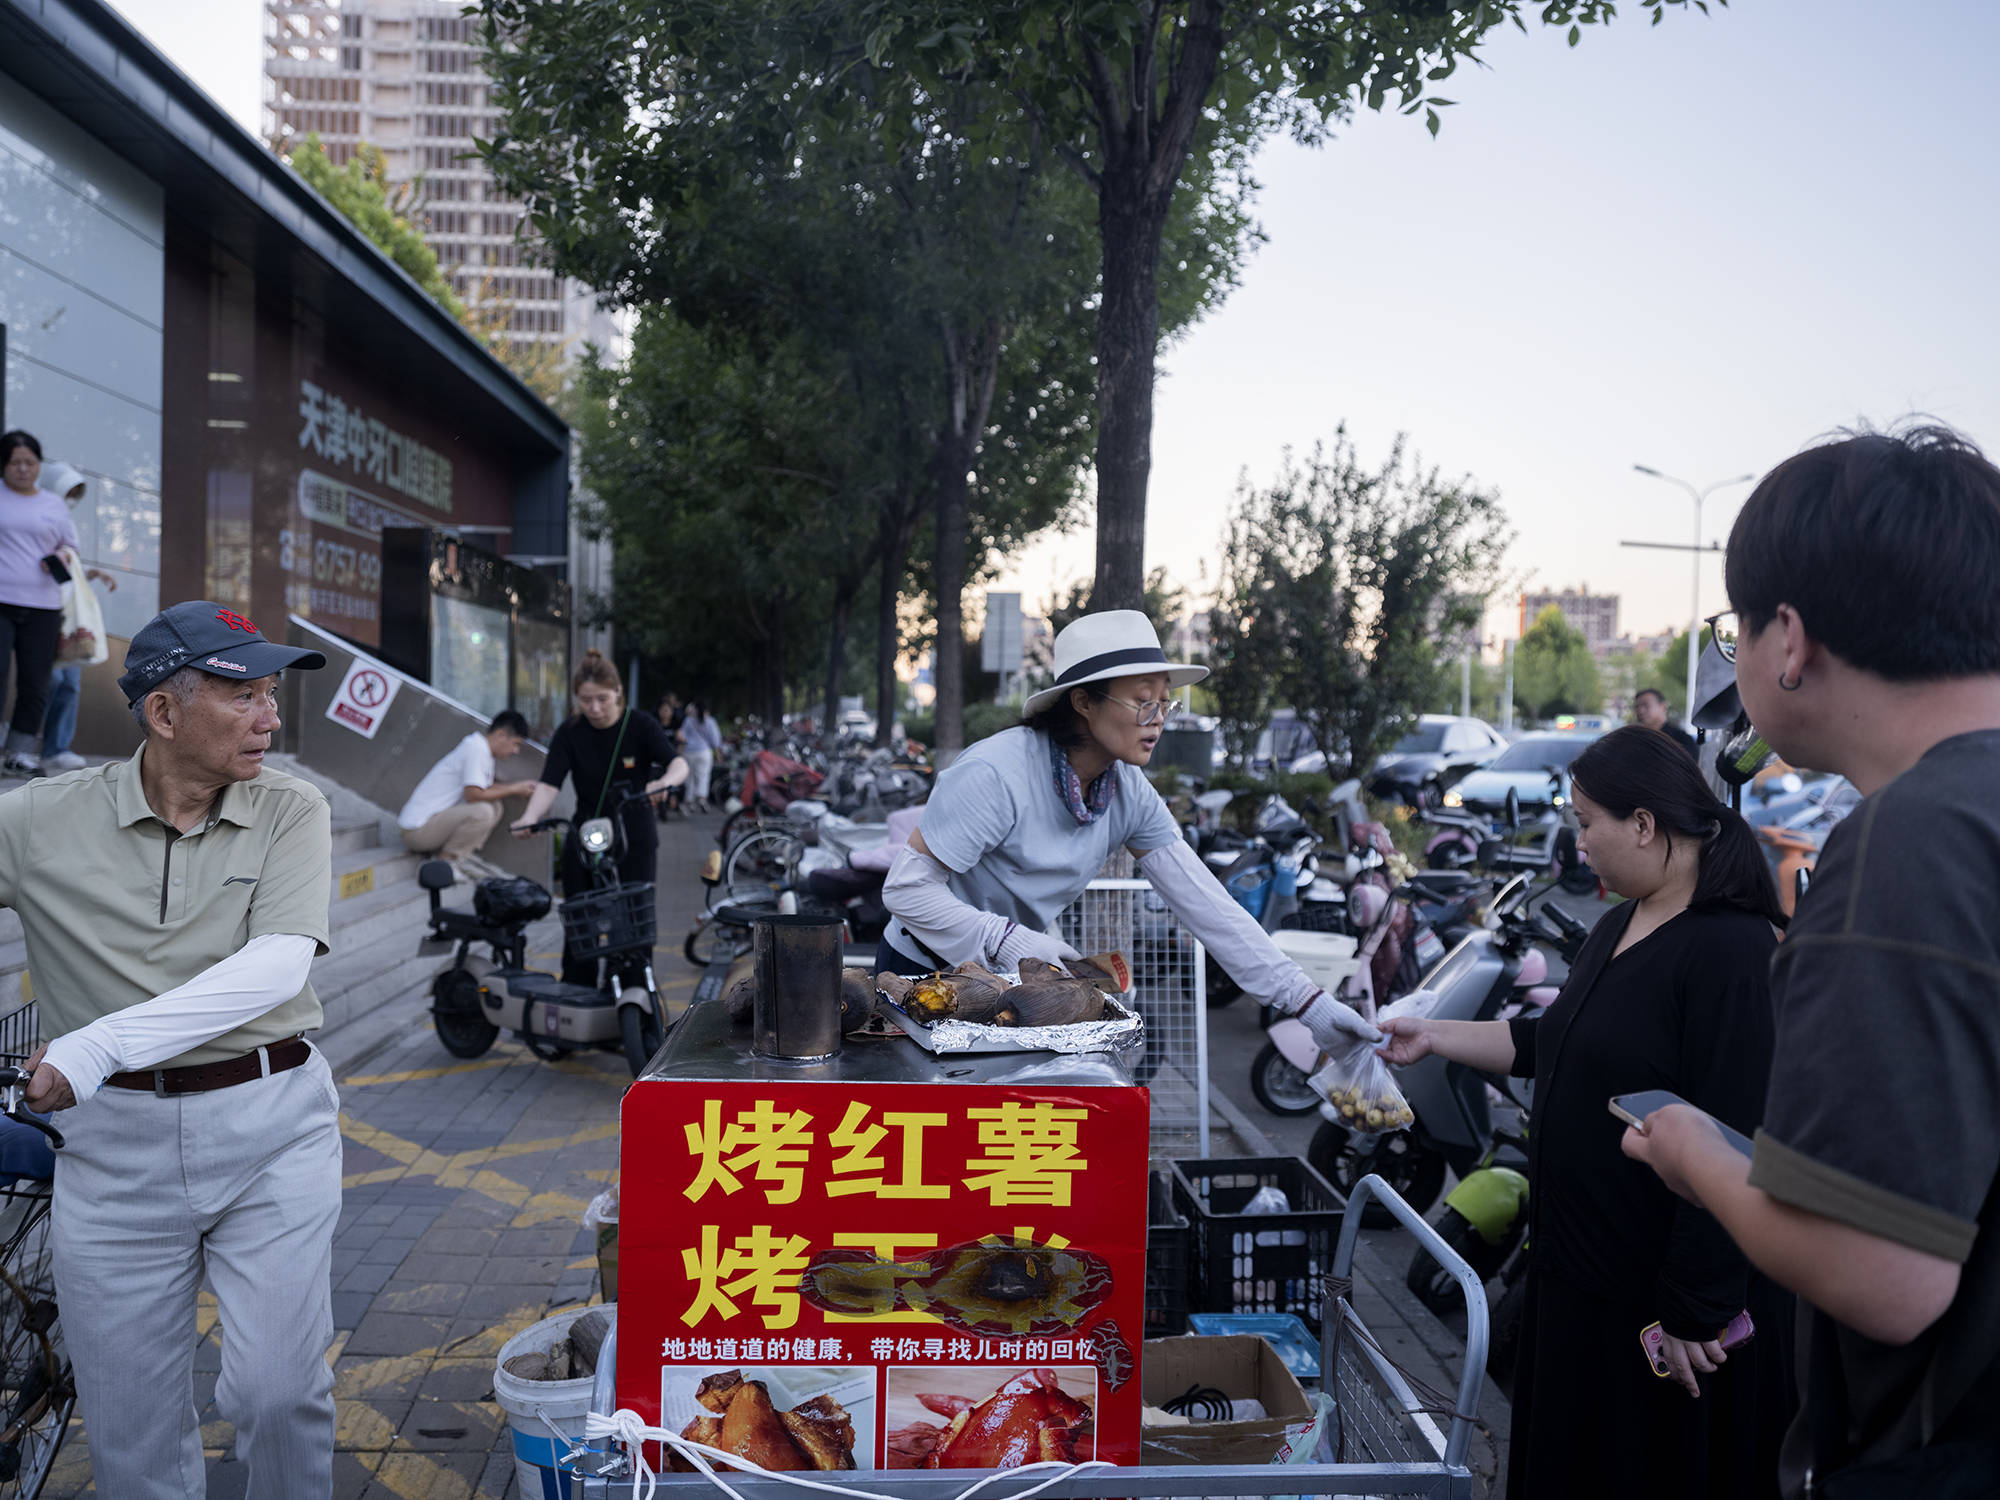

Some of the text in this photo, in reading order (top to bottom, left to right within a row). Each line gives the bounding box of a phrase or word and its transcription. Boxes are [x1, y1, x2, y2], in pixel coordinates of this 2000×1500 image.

[141, 647, 186, 674] CAPITALLINK
[682, 1100, 1088, 1207] 烤红薯
